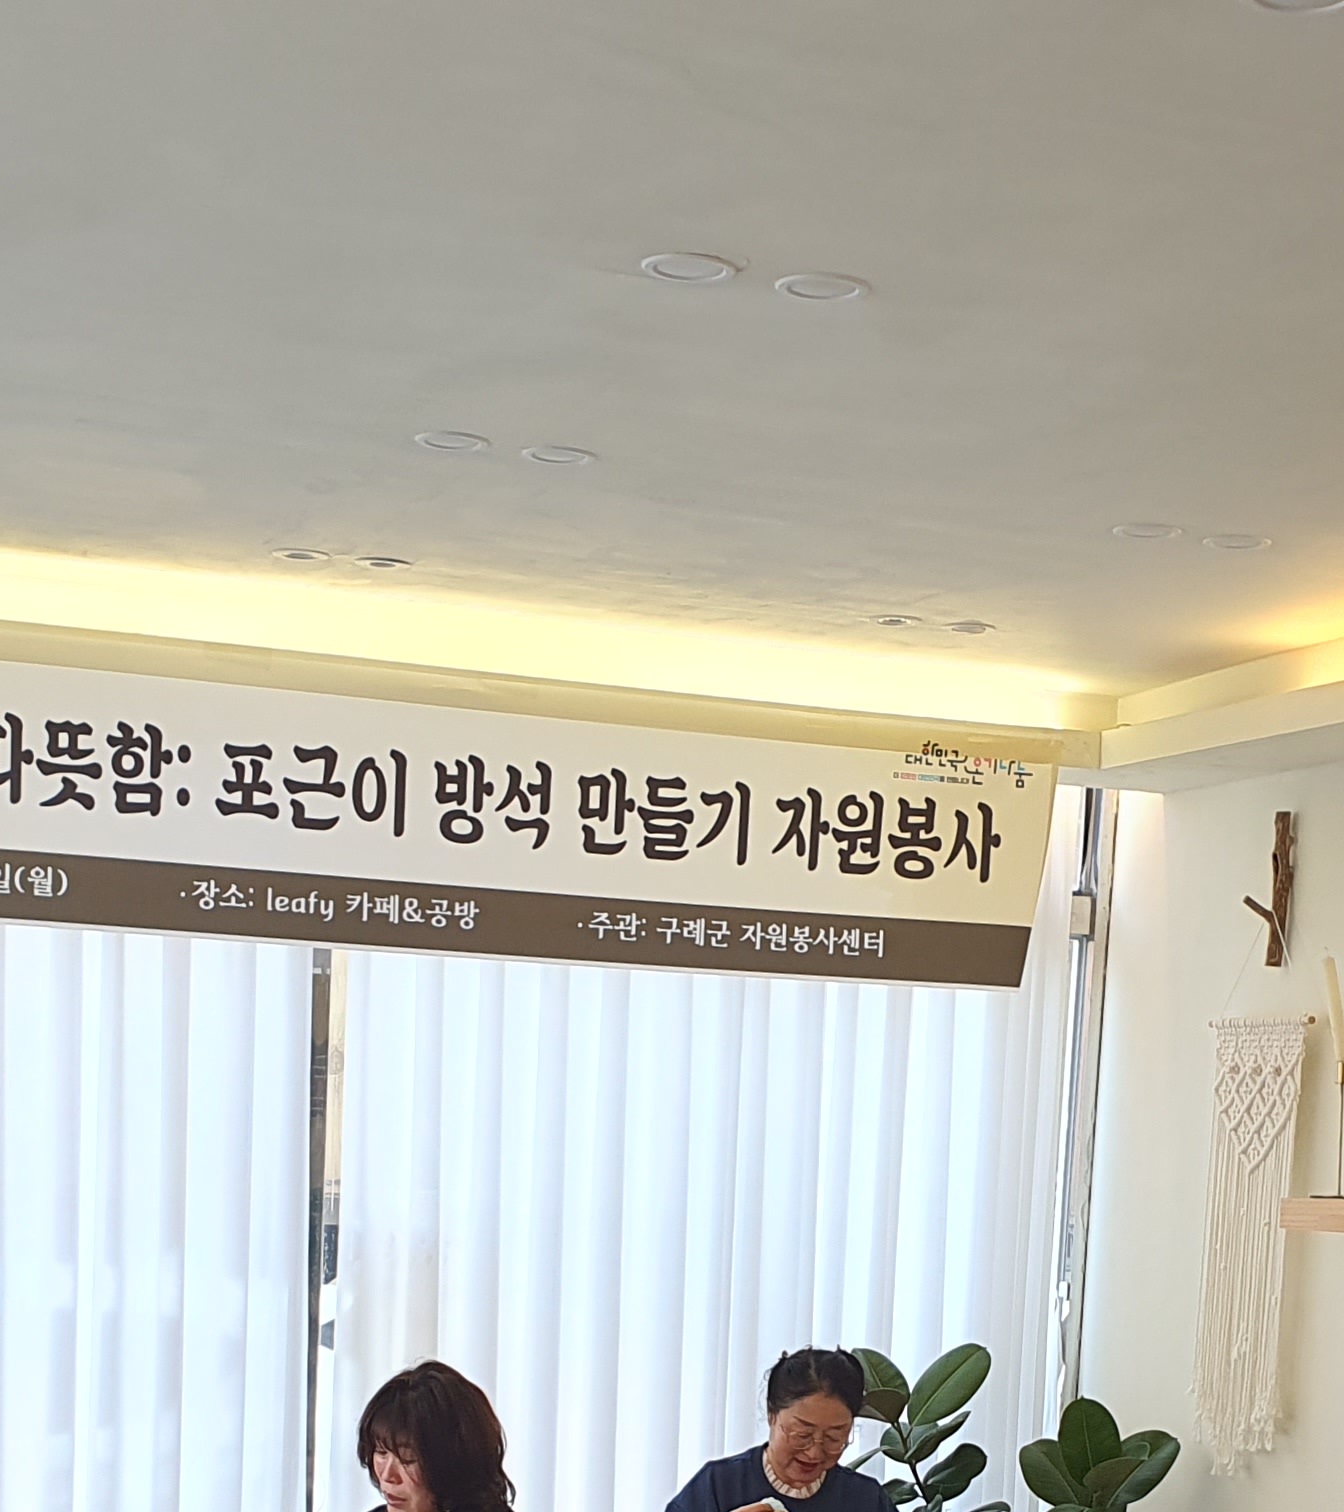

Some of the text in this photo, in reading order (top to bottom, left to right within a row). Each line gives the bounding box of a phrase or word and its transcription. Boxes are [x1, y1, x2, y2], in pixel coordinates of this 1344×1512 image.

[214, 742, 408, 839] 포근이
[433, 753, 554, 851] 방석
[576, 766, 752, 867] 만들기
[770, 786, 1003, 884] 자원봉사
[266, 886, 335, 922] leafy
[345, 890, 481, 930] 카페&공방
[655, 916, 732, 949] 구례군
[738, 920, 885, 959] 자원봉사센터
